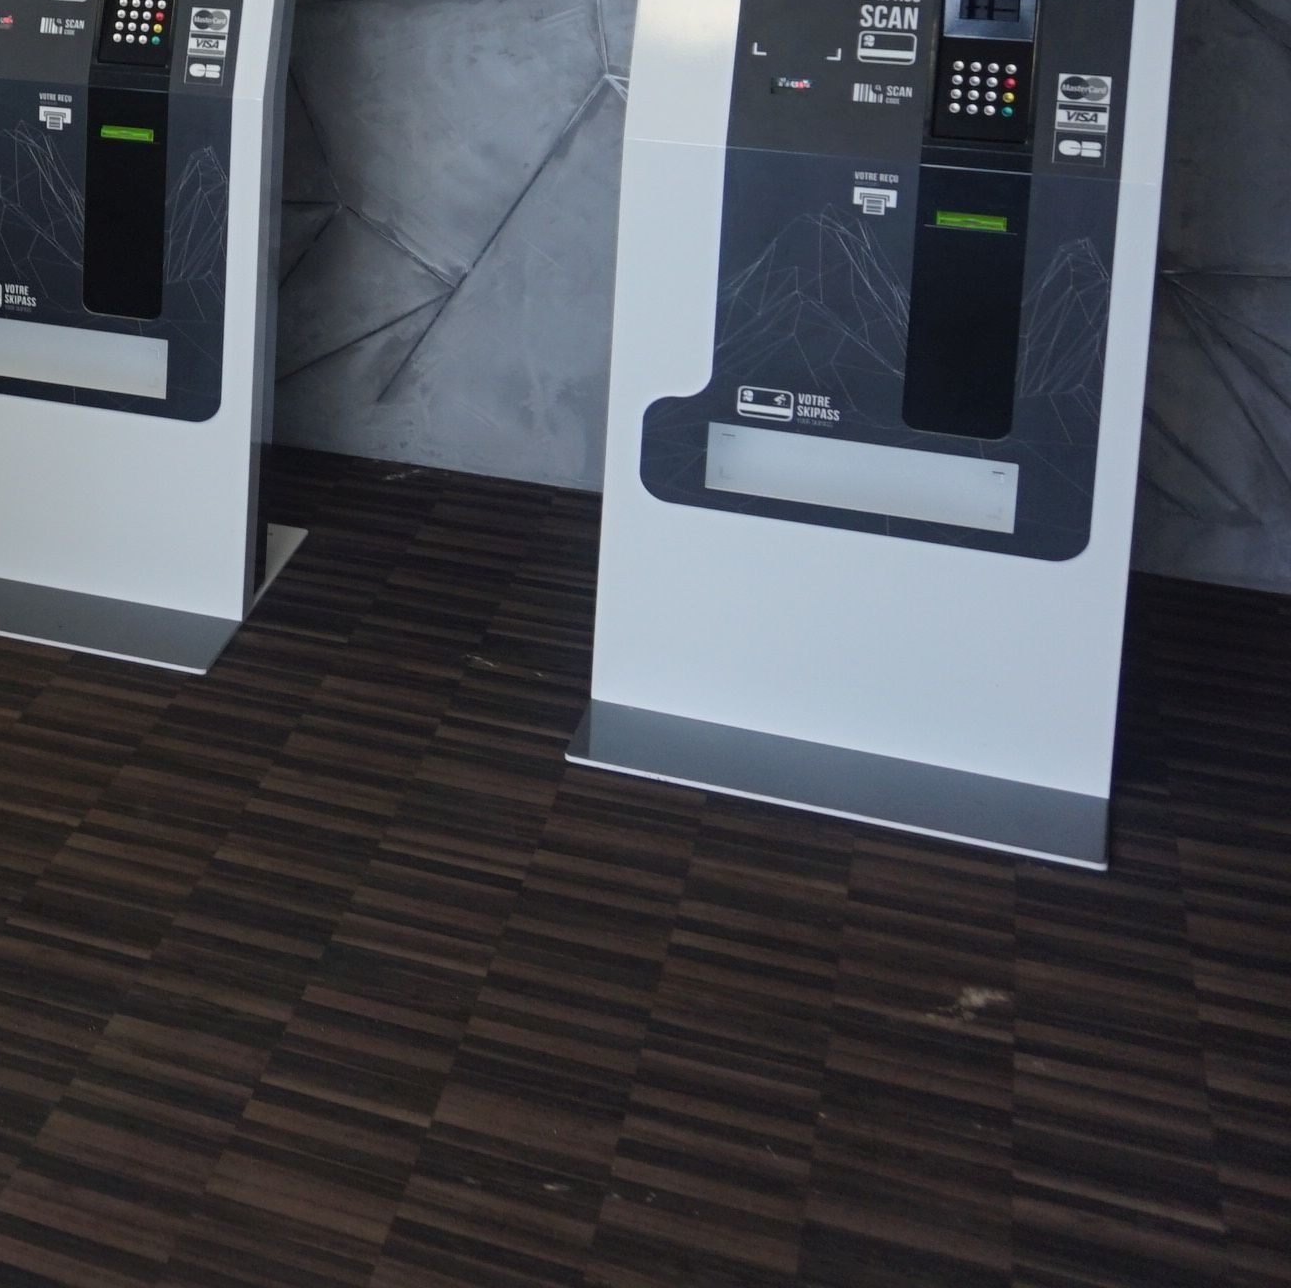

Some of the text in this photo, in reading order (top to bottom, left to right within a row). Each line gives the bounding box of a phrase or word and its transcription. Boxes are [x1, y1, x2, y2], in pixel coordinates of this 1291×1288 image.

[65, 18, 85, 30] SCAN
[194, 15, 227, 25] MasterCard
[859, 4, 920, 31] SCAN
[195, 39, 219, 50] VISA
[886, 85, 913, 98] SCAN
[1061, 82, 1108, 95] MasterCard
[1065, 111, 1099, 124] VISA
[854, 171, 899, 184] VOTRE REÇU
[5, 283, 29, 296] VOTRE
[5, 294, 37, 307] SKIPASS
[798, 393, 831, 408] VOTRE
[797, 405, 840, 421] SKIPASS
